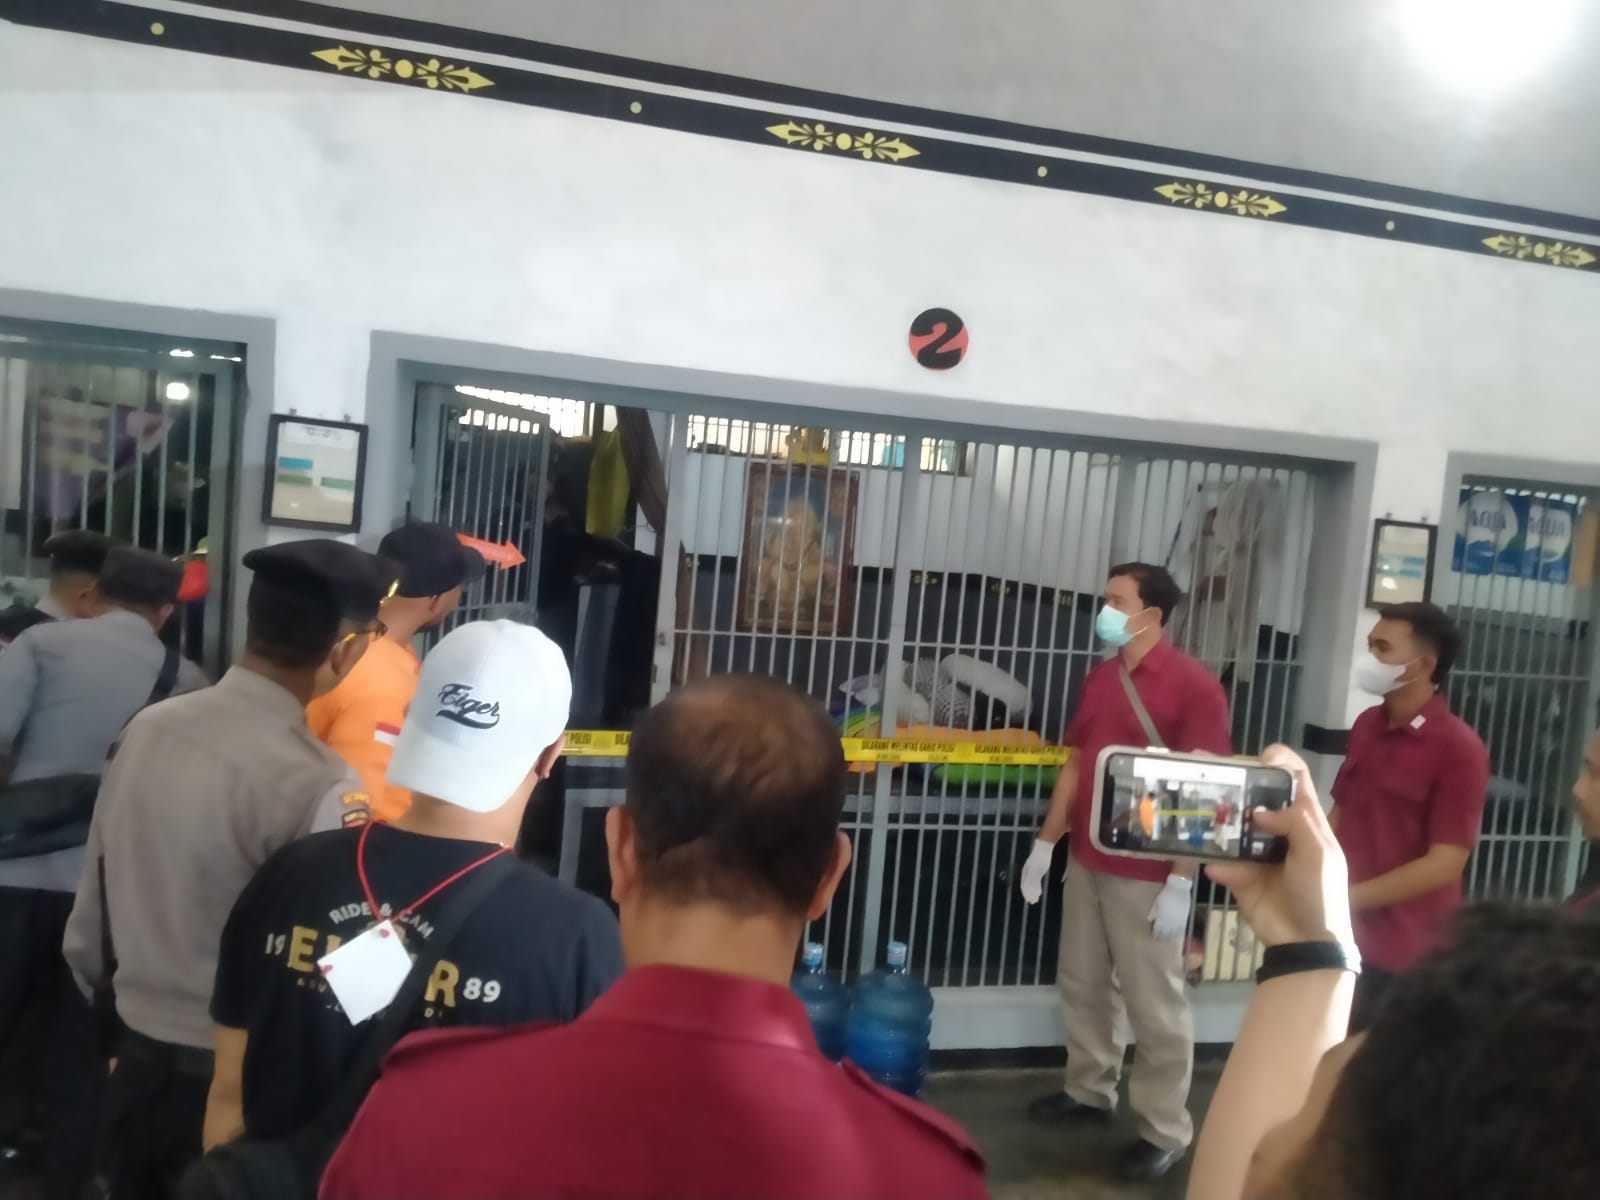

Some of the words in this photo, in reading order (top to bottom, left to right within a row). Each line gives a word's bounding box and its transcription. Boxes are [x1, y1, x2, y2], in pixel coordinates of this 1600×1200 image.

[910, 307, 964, 370] 2
[437, 683, 500, 729] Eiger
[569, 732, 592, 745] POLISI
[615, 733, 630, 745] DILA
[329, 902, 373, 924] RIDE
[380, 902, 393, 917] &
[400, 910, 435, 939] CAM
[264, 932, 287, 956] 19
[462, 976, 501, 1003] 89
